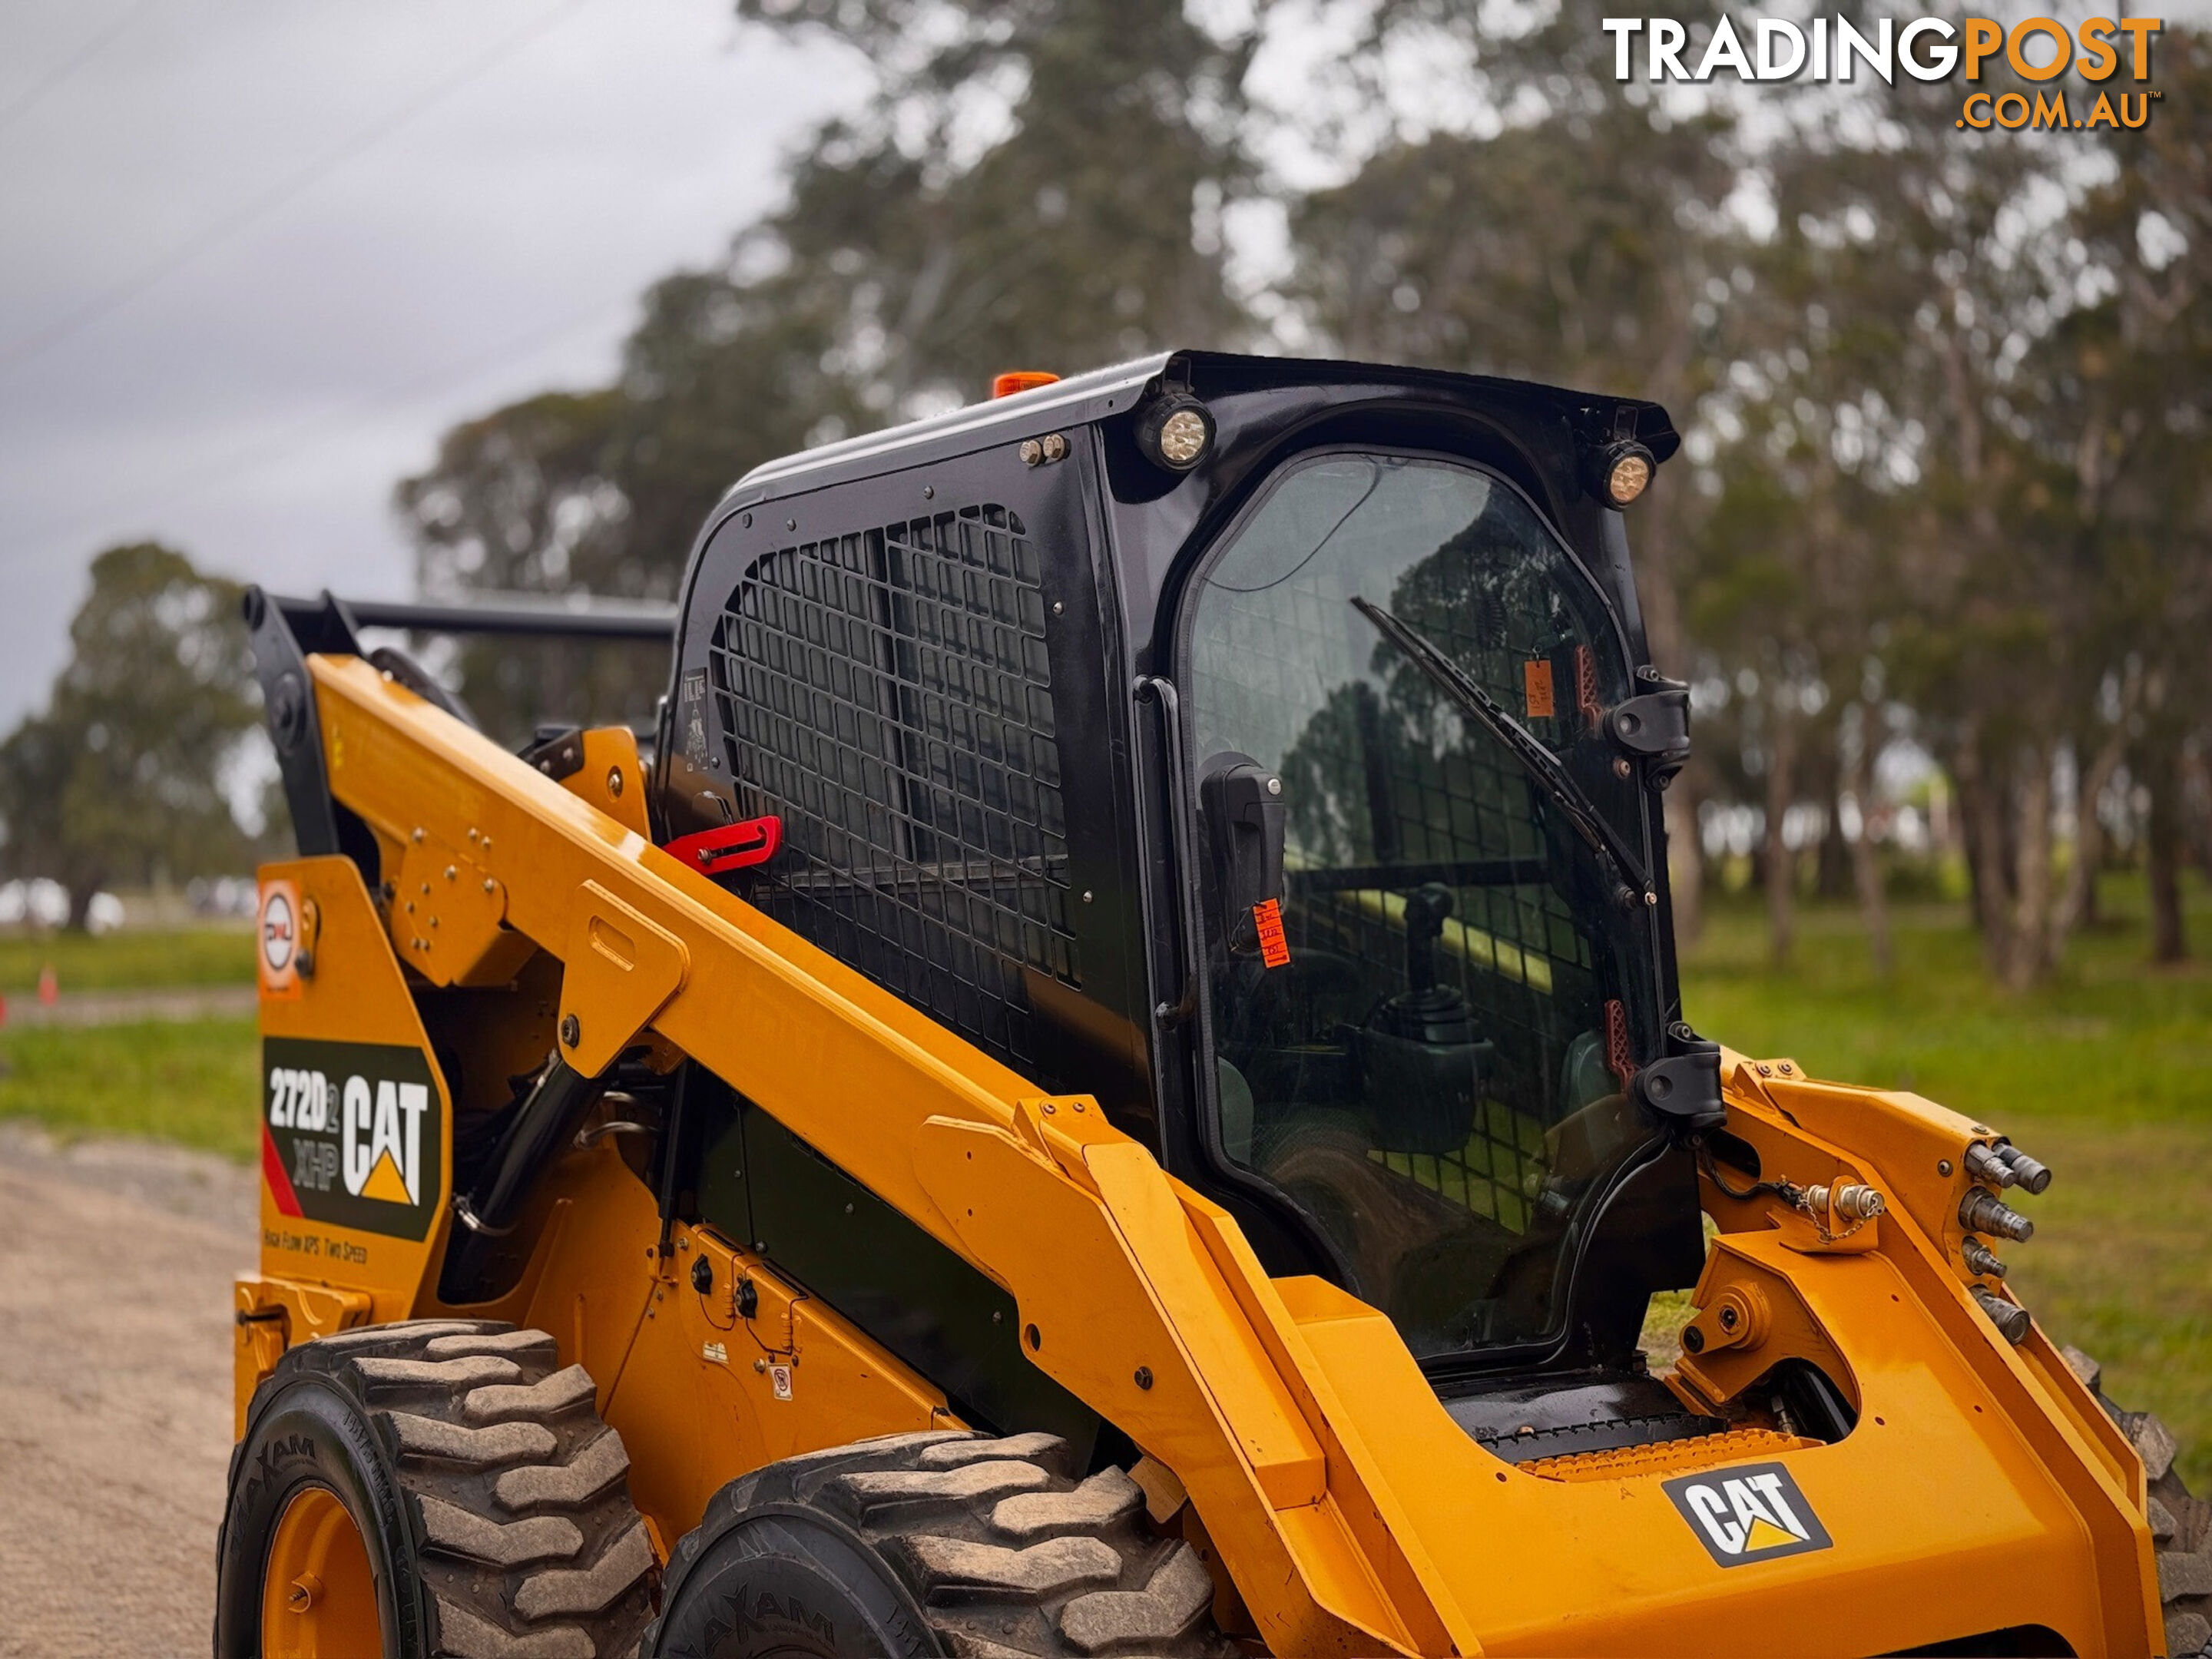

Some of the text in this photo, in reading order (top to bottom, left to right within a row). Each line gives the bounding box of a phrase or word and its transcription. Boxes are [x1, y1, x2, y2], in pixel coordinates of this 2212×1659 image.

[293, 1139, 339, 1192] XHP
[343, 1075, 428, 1207] CAT
[304, 1234, 320, 1256] XPS
[1685, 1472, 1810, 1555] CAT
